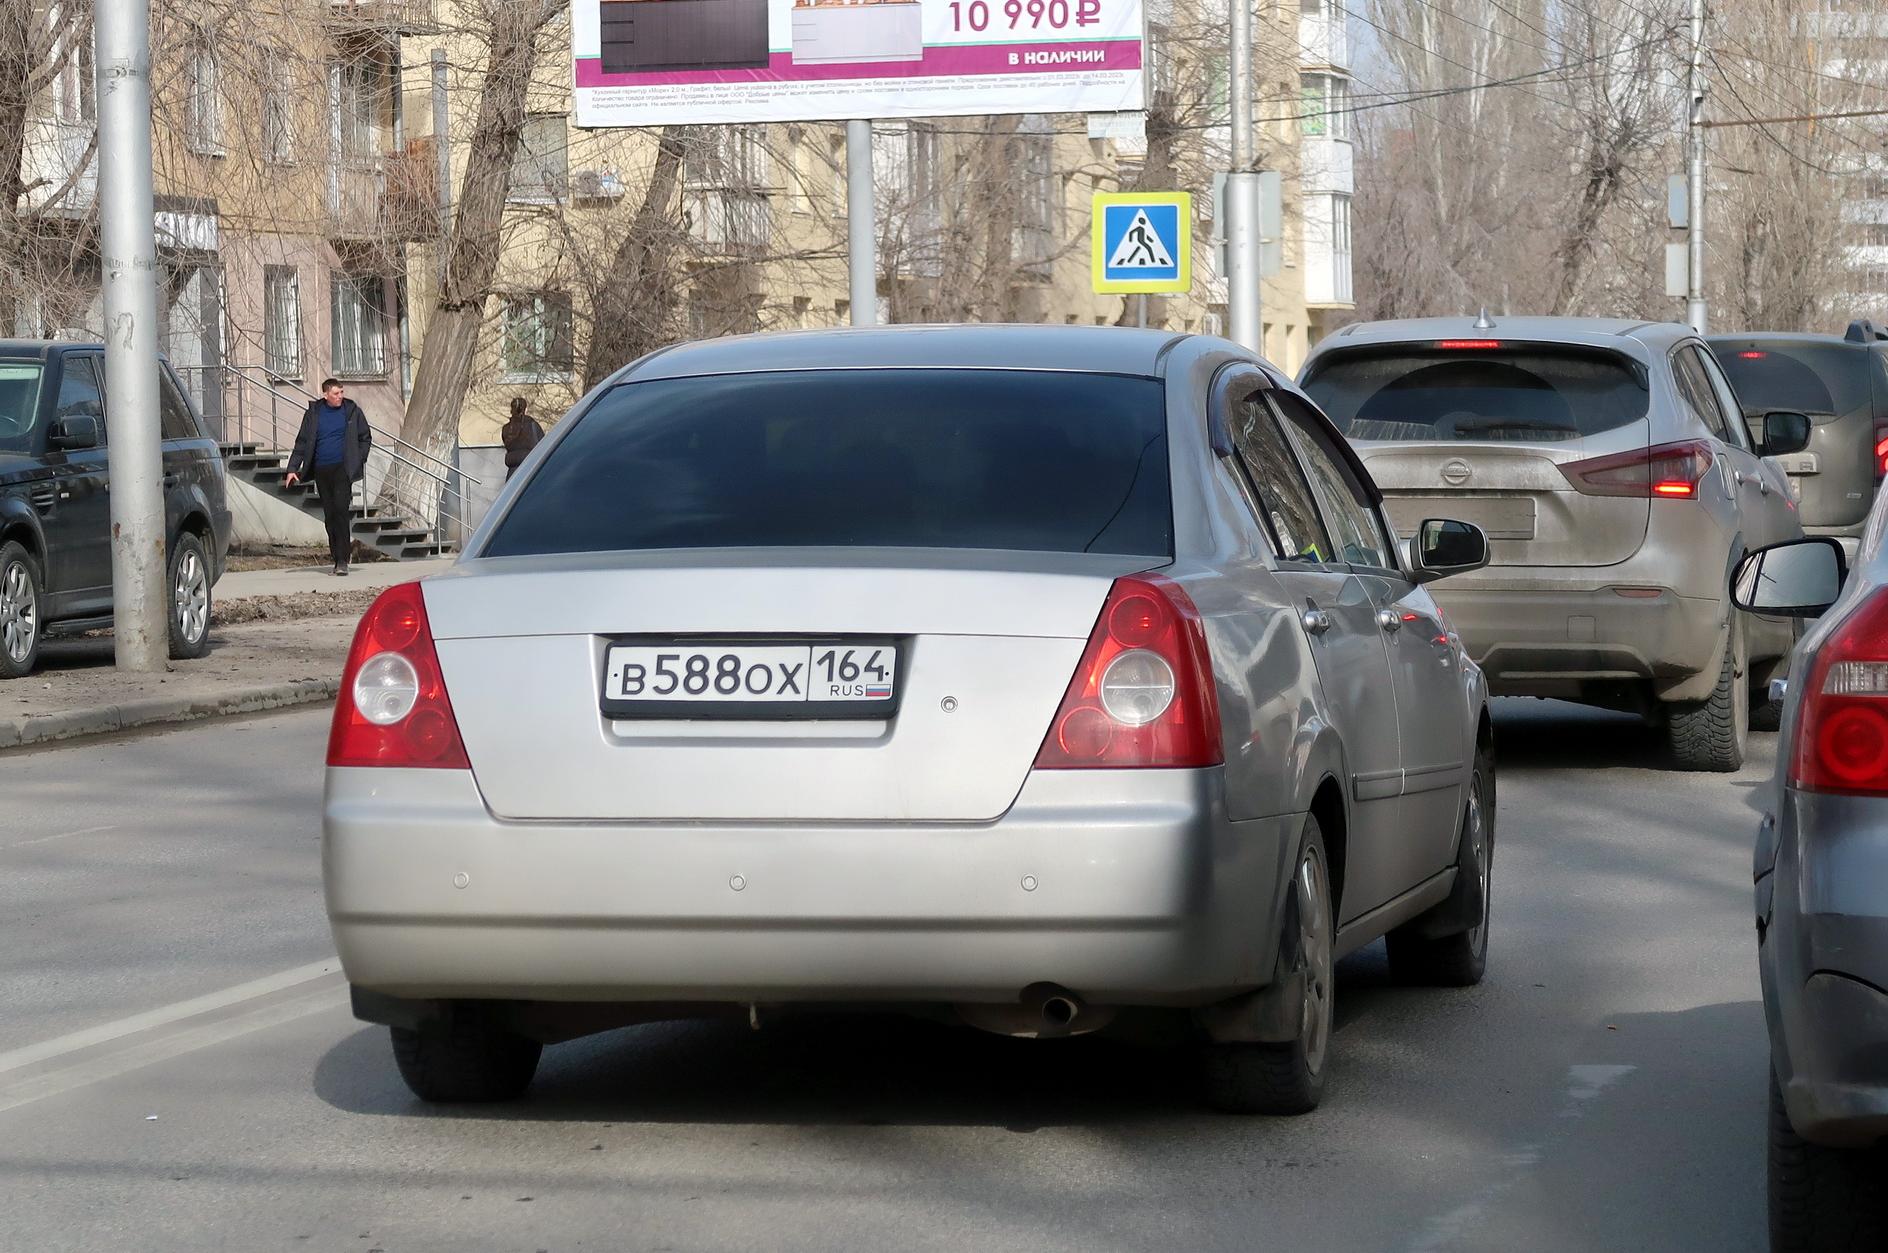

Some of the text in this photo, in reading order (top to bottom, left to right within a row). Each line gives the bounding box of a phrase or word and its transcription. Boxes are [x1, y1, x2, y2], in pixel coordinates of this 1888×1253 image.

[949, 0, 989, 32] 10
[1008, 50, 1105, 65] в наличии
[816, 650, 885, 682] 164
[829, 684, 864, 696] RUS
